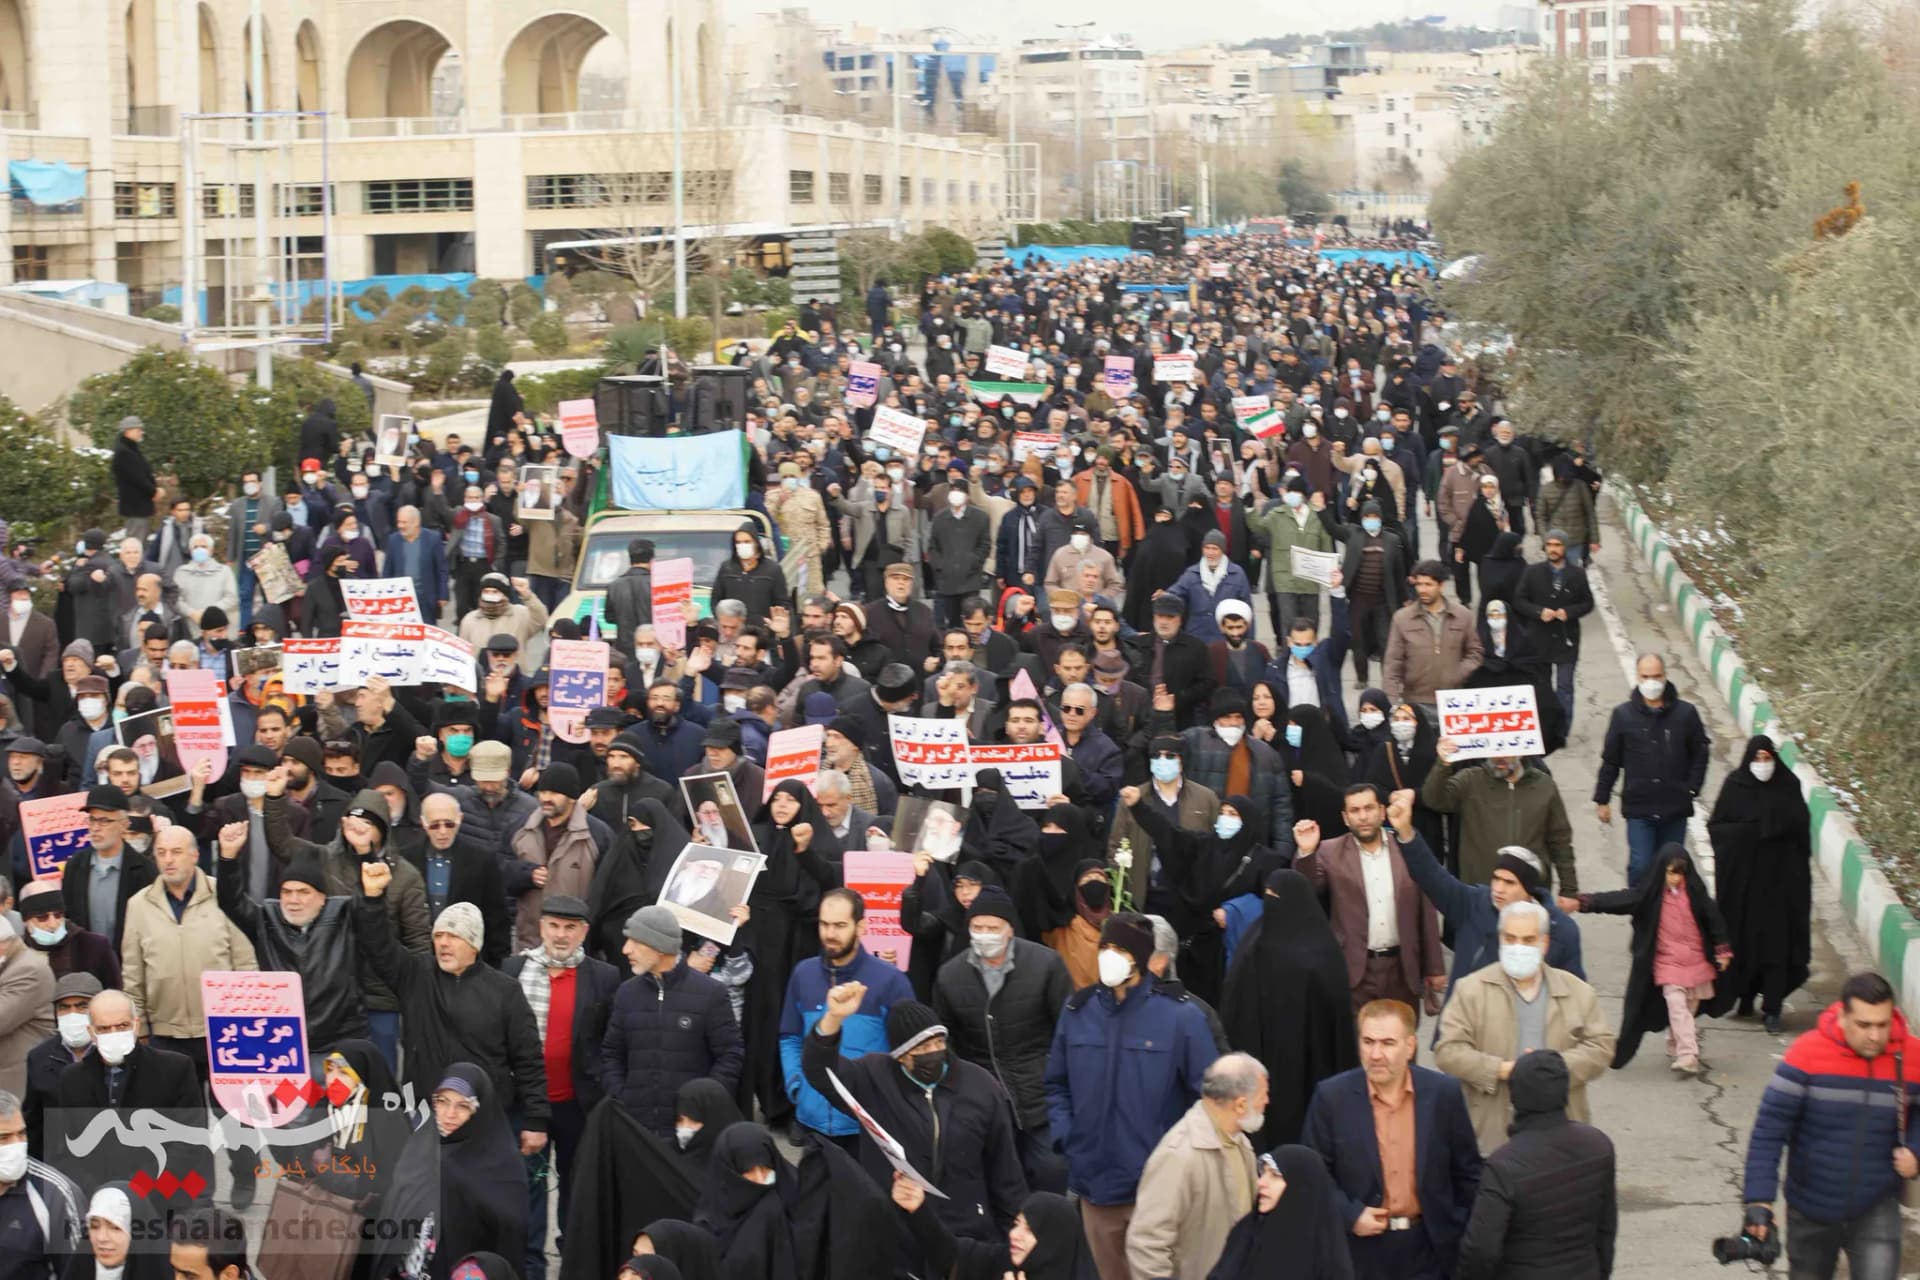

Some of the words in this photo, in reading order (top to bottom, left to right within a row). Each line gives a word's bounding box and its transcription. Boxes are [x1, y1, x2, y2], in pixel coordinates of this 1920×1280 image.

[555, 675, 569, 688] بر
[570, 672, 600, 690] مرگ
[553, 690, 600, 708] امریکا
[1445, 694, 1480, 712] آمریکا
[1500, 694, 1527, 710] مرگ
[1445, 714, 1490, 734] اسرائیل
[1491, 718, 1505, 732] بر
[1504, 713, 1535, 731] مرگ
[934, 728, 958, 742] مرگ
[1508, 735, 1535, 750] مرگ
[936, 746, 967, 763] مرگ
[1015, 746, 1034, 761] آخر
[941, 768, 968, 782] مرگ
[217, 1023, 239, 1044] بر
[241, 1018, 294, 1044] مرگ
[217, 1047, 299, 1073] امریکا
